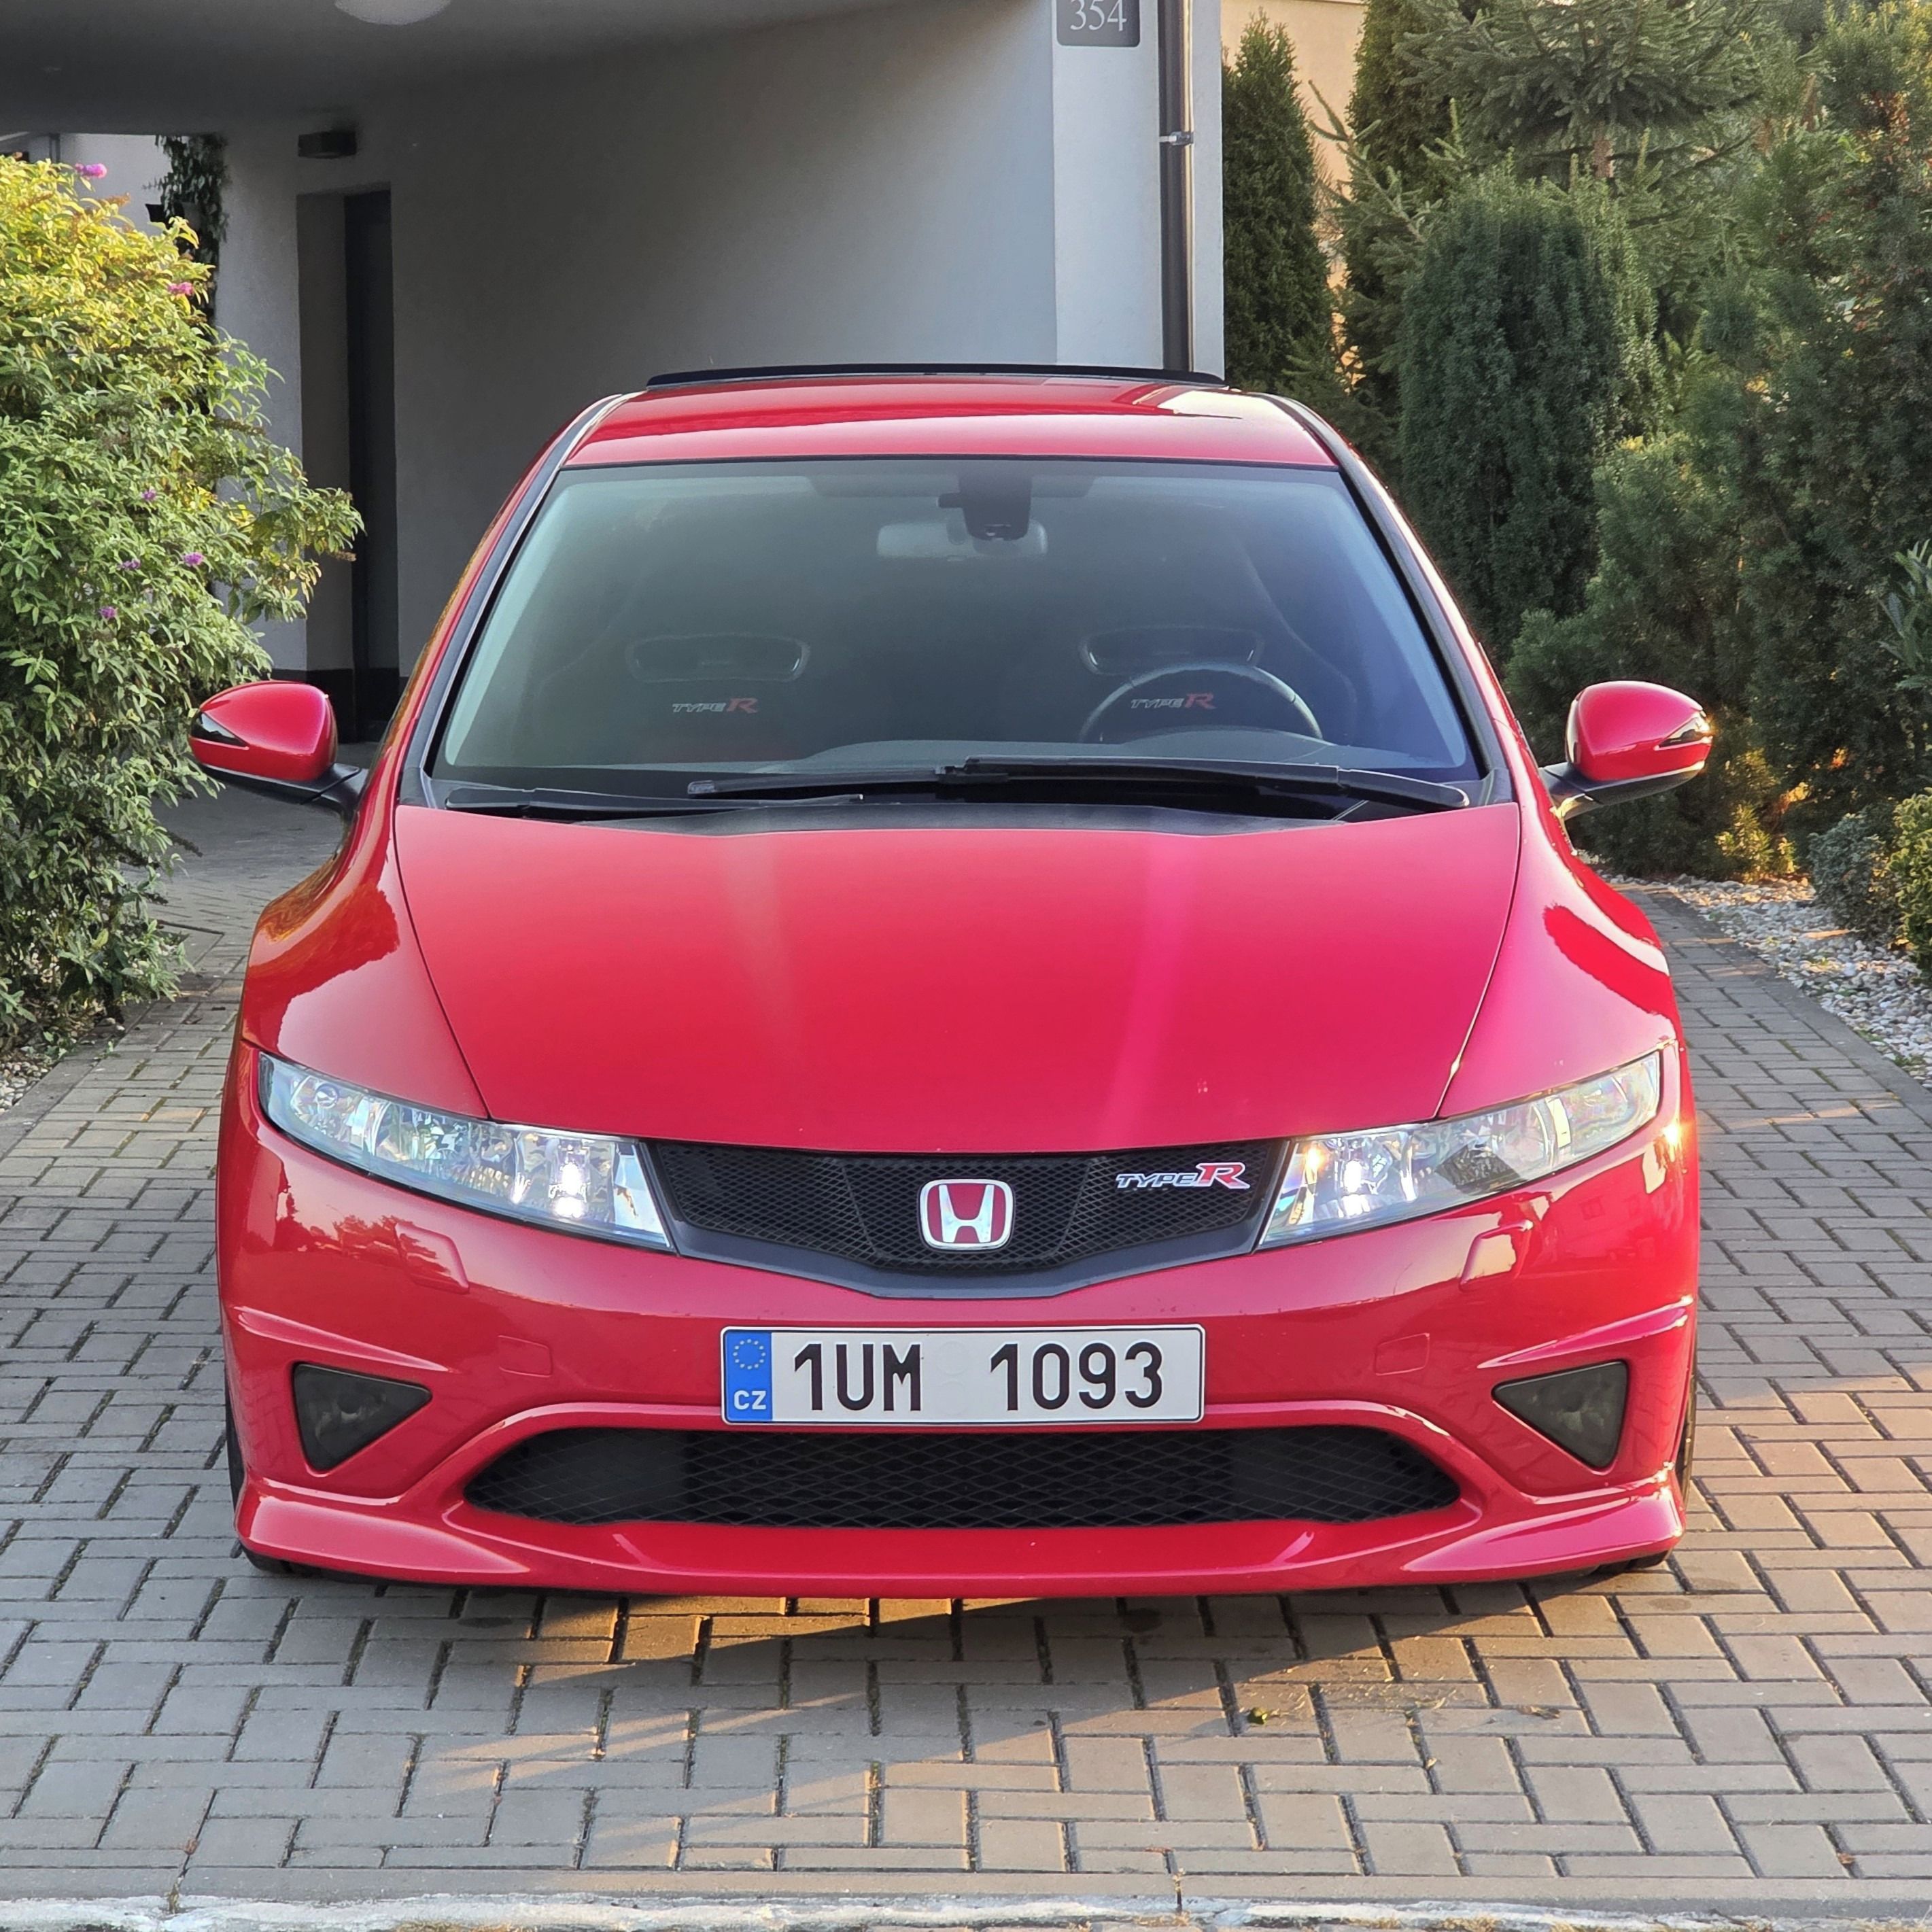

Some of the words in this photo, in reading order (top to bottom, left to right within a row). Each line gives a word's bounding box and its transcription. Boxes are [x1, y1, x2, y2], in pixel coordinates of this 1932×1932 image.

[1070, 0, 1127, 31] 354
[794, 1343, 921, 1412] 1UM
[990, 1341, 1163, 1412] 1093
[734, 1390, 767, 1411] CZ
